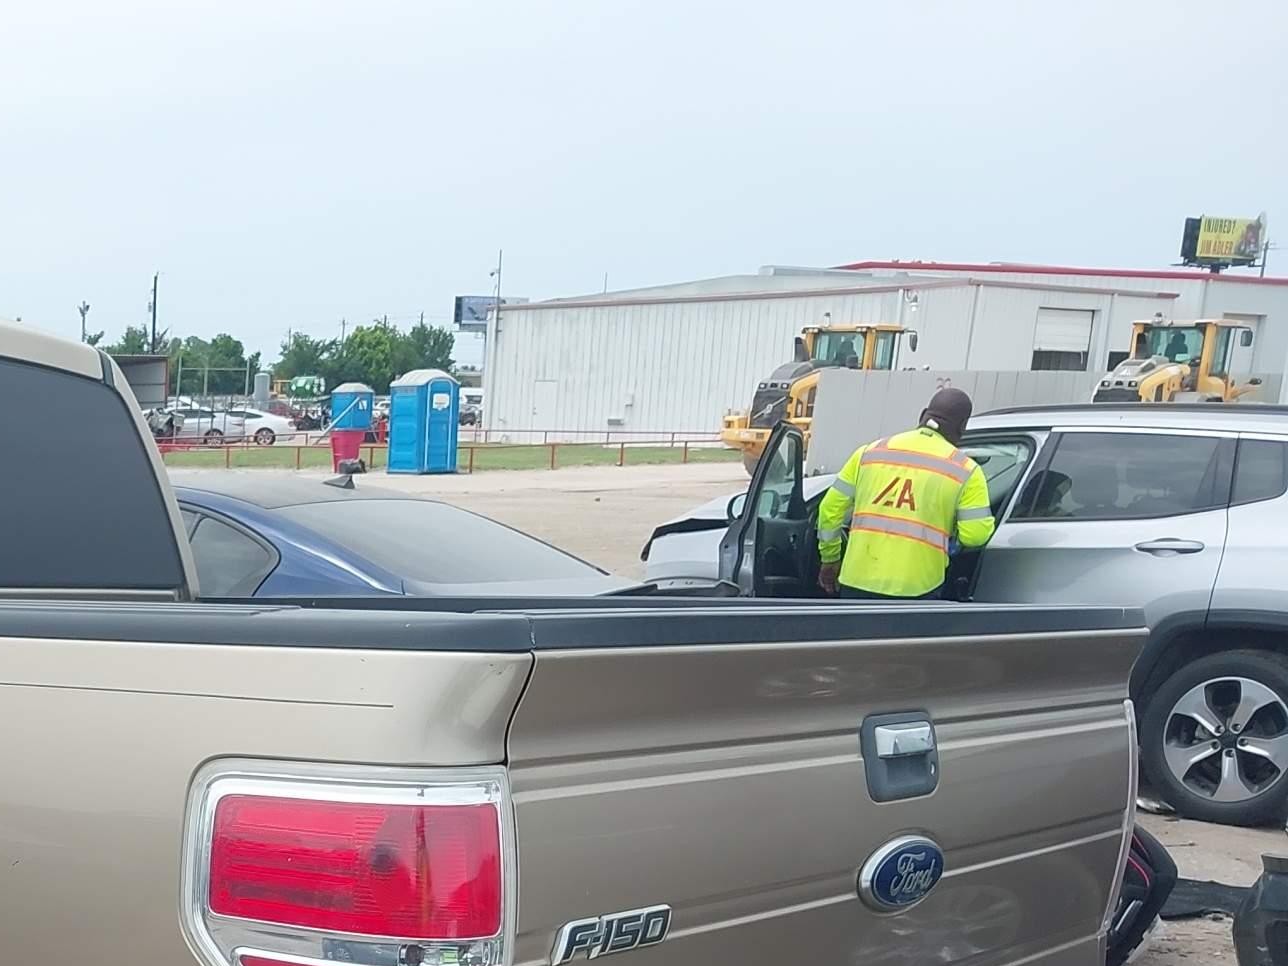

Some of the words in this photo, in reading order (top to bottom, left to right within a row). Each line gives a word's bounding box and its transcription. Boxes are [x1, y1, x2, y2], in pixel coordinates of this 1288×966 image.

[1203, 217, 1237, 235] INJURED?
[889, 851, 936, 897] Ford
[551, 903, 672, 966] F-150
